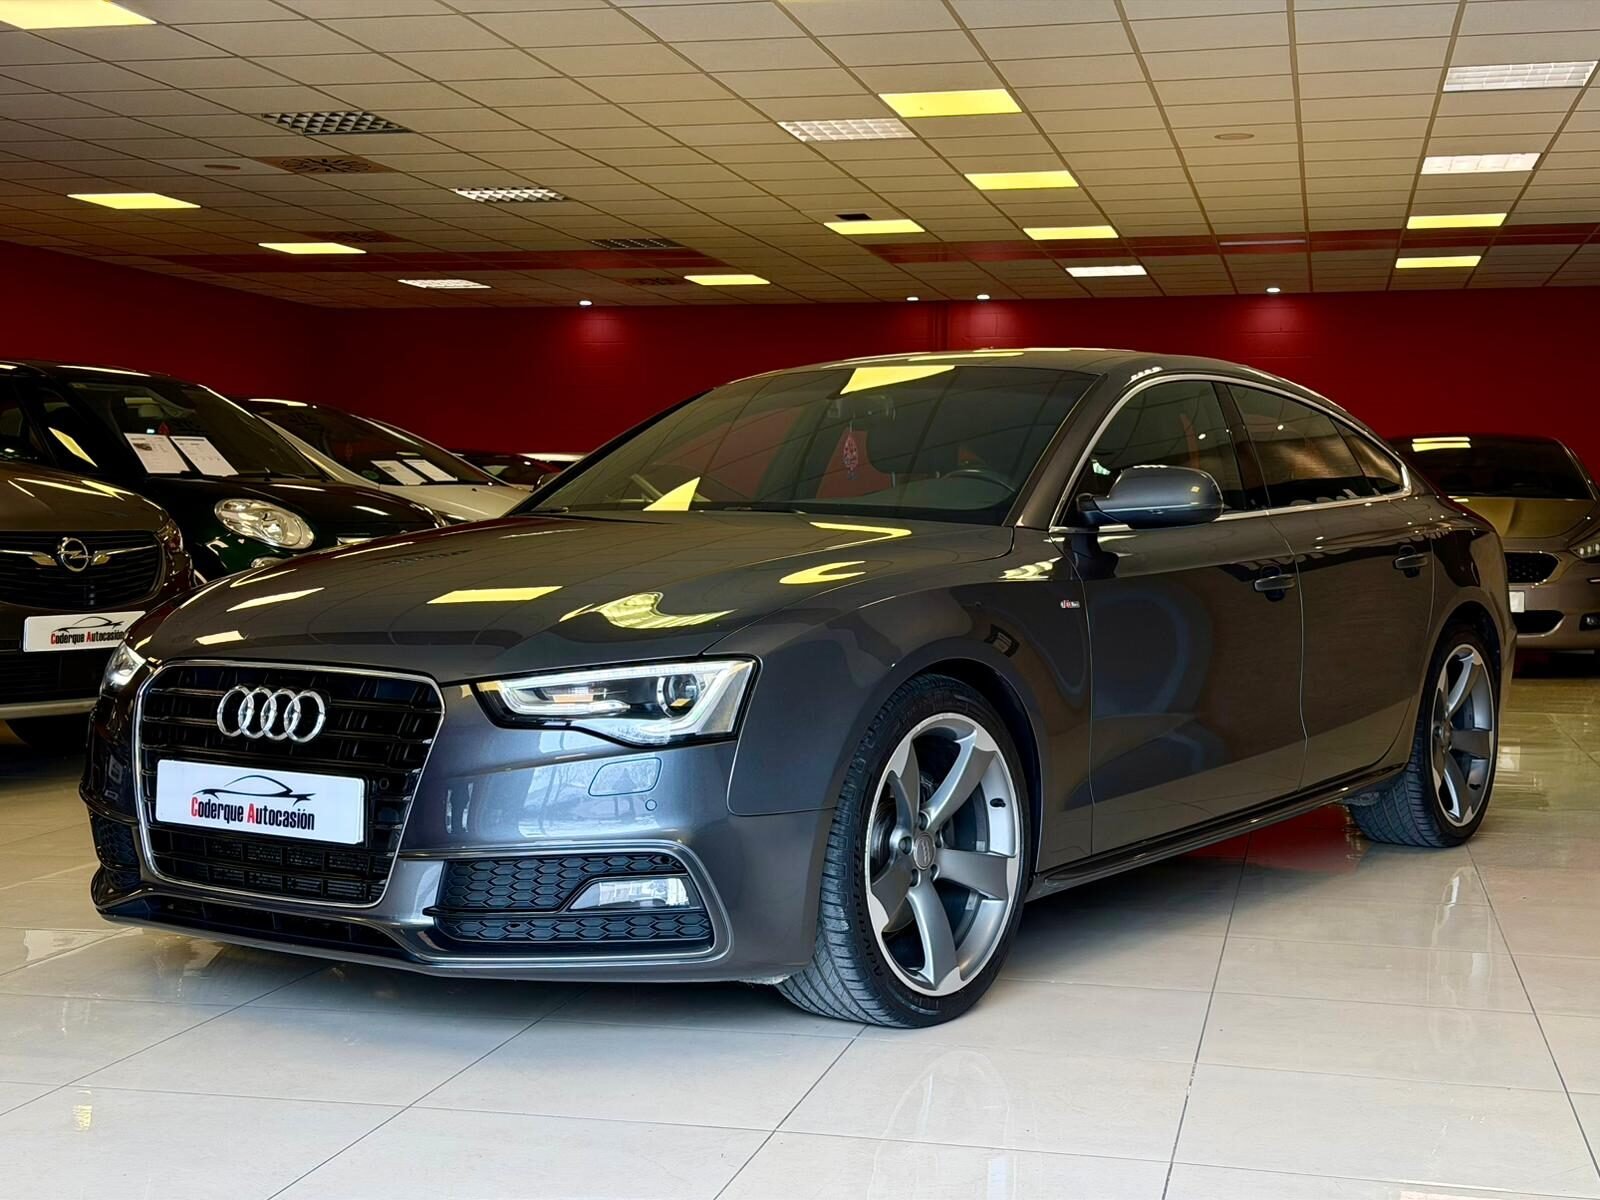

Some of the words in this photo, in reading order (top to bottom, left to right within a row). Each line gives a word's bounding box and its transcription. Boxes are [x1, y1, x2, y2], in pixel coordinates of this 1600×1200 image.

[50, 632, 85, 645] Coderque
[191, 796, 244, 824] Coderque
[247, 803, 315, 830] Autocasión
